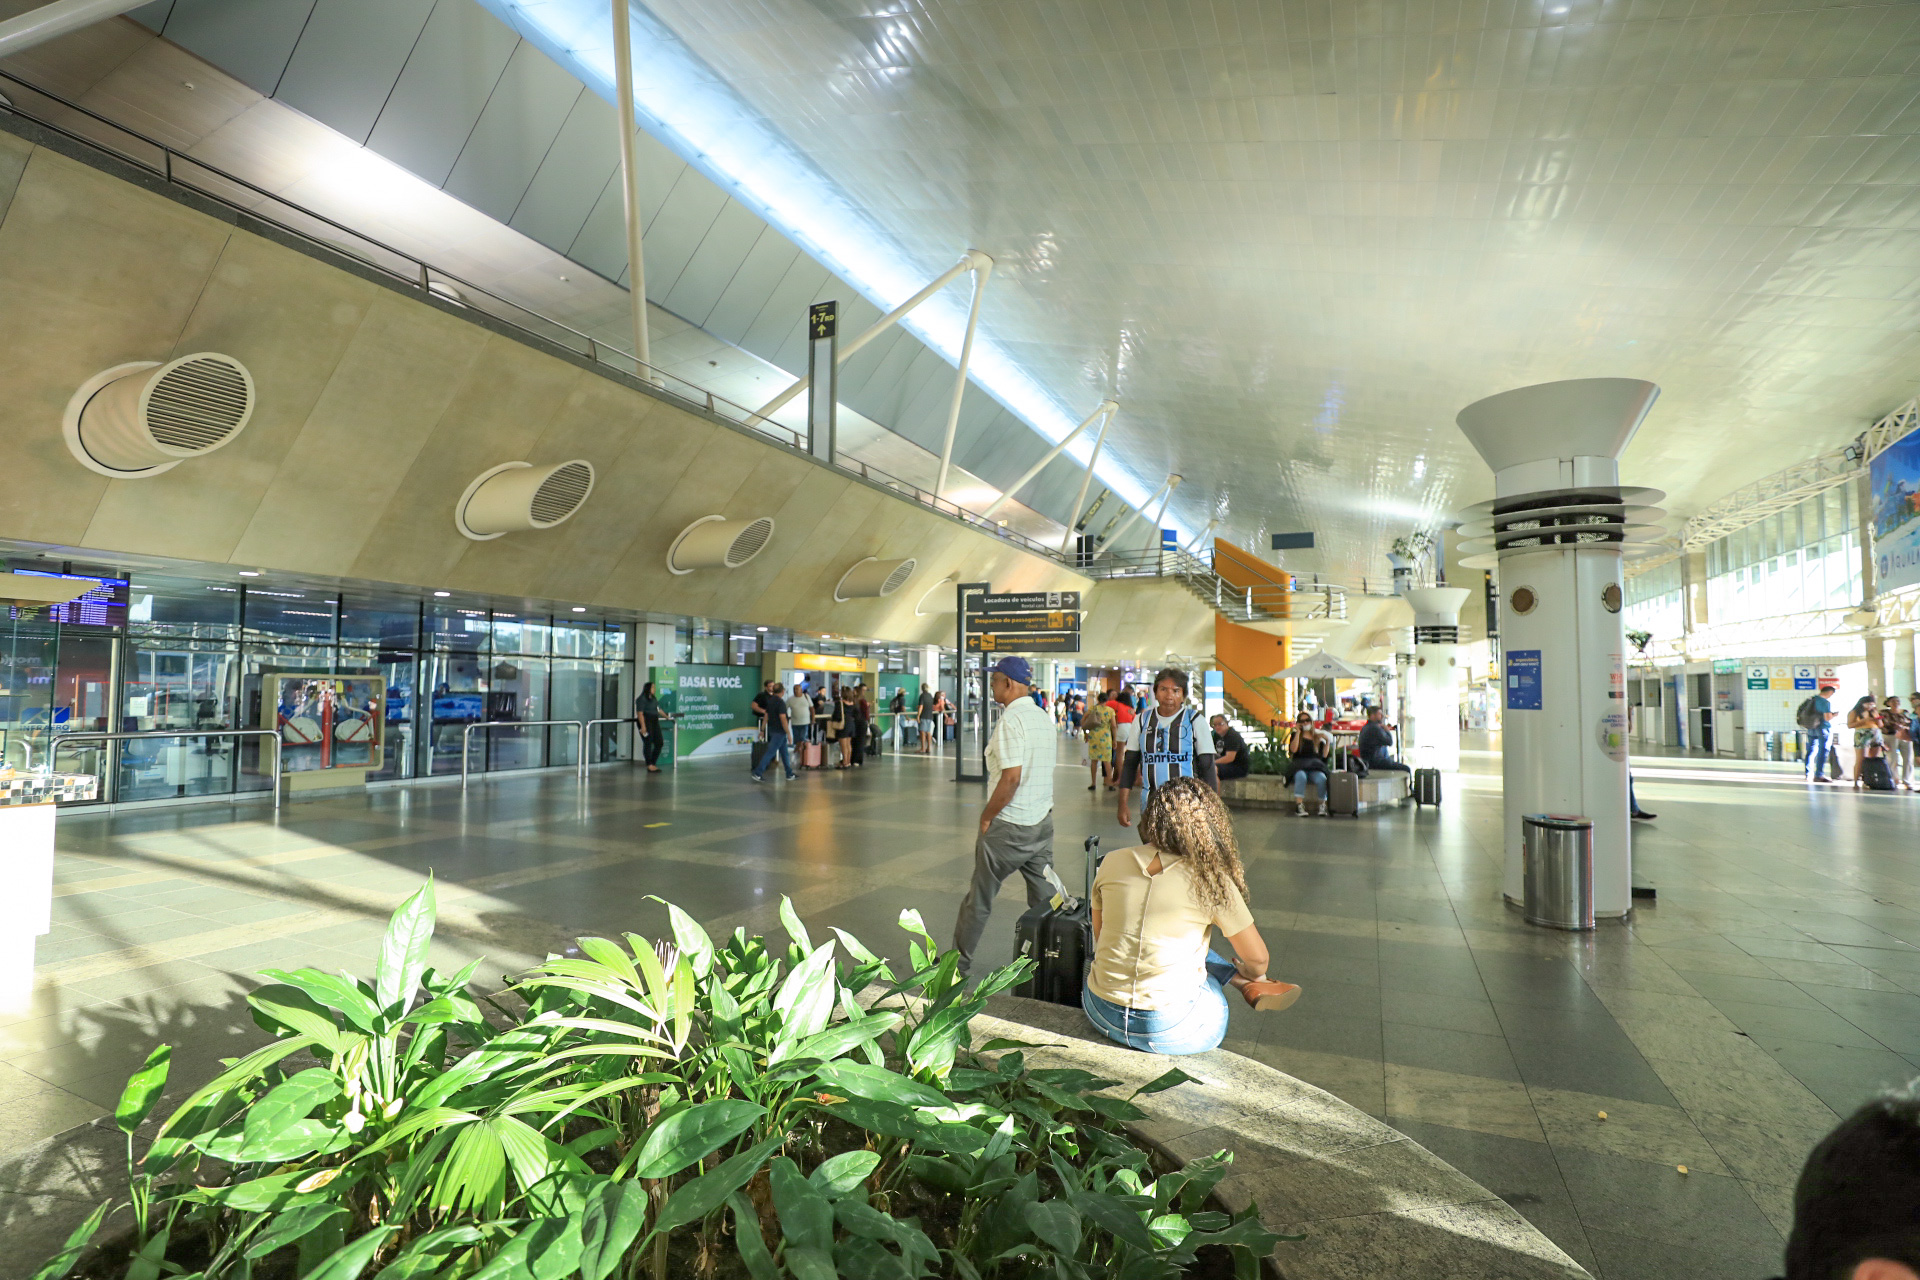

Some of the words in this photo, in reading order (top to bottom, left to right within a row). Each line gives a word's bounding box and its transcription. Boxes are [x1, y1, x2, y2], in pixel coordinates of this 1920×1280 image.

[679, 676, 707, 688] BASA
[709, 676, 716, 688] E
[717, 675, 743, 688] VOCÊ.
[679, 694, 684, 702] A
[685, 694, 708, 703] parceria
[687, 722, 714, 730] Amazônia.
[1143, 752, 1189, 763] Banrisul
